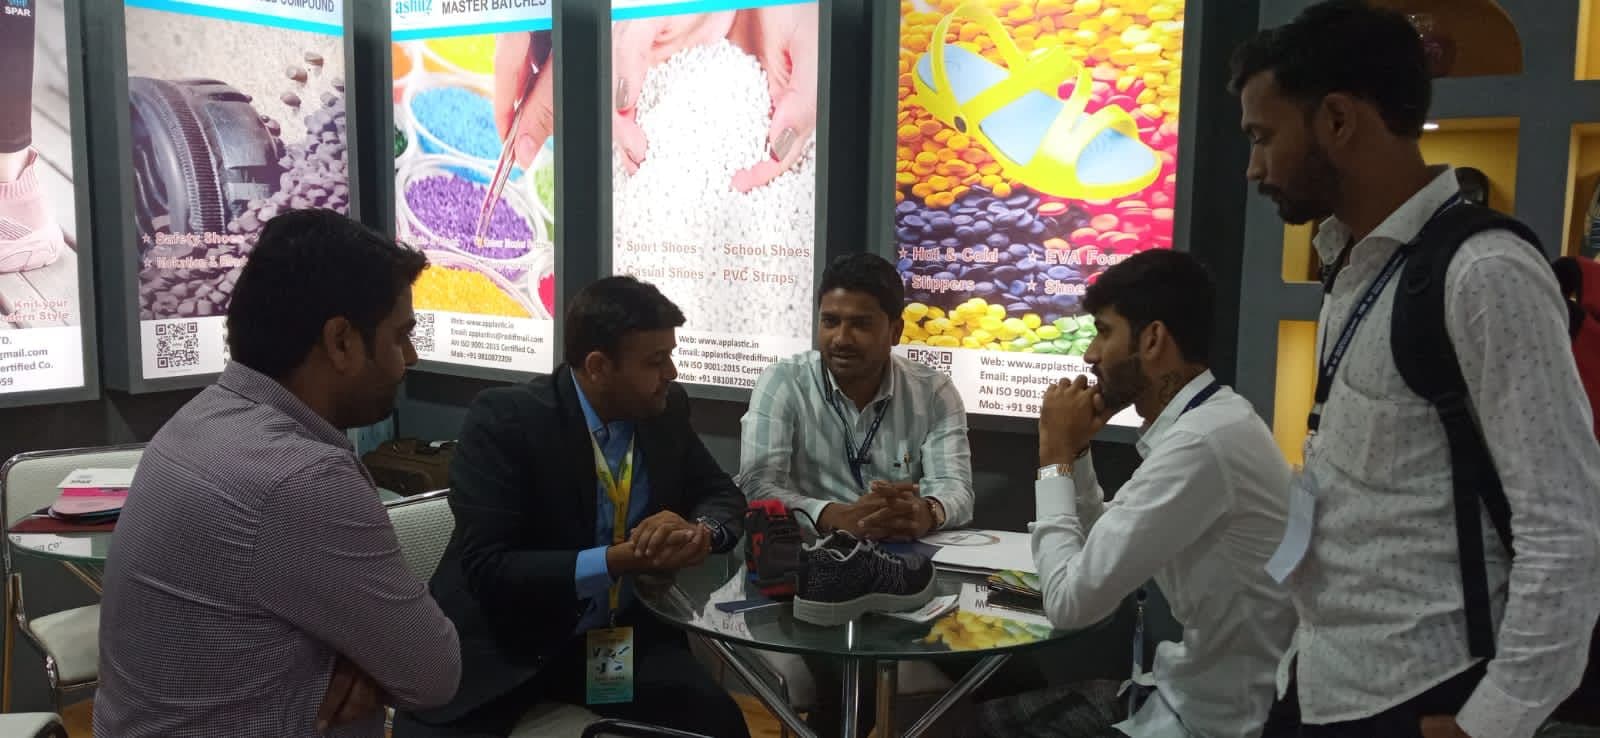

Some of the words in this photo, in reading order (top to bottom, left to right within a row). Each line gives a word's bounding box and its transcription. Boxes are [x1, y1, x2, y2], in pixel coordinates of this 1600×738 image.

[4, 6, 32, 17] SPAR
[441, 0, 489, 15] MASTER
[626, 240, 657, 254] Sport
[661, 240, 697, 254] Shoes
[723, 243, 767, 256] School
[770, 244, 810, 258] Shoes
[912, 247, 941, 262] Hot
[948, 248, 957, 262] &
[961, 247, 998, 263] Cold
[1045, 249, 1082, 264] EVA
[626, 265, 665, 278] Casual
[668, 266, 704, 280] Shoes
[723, 268, 749, 282] PVC
[752, 270, 795, 286] Straps
[911, 274, 976, 293] Slippers
[1045, 280, 1088, 296] Shoe
[39, 311, 70, 322] Style
[678, 335, 697, 344] Web:
[698, 337, 760, 349] www.applastic.in
[678, 347, 700, 357] Email:
[701, 349, 778, 364] applastics@rediffmail
[0, 361, 36, 373] ertified
[38, 361, 54, 370] Co.
[678, 360, 689, 368] AN
[690, 360, 703, 369] ISO
[704, 361, 740, 373] 9001:2015
[741, 365, 764, 375] Certif
[980, 355, 1005, 367] Web:
[1007, 359, 1092, 374] www.applastic.in
[678, 372, 697, 382] Mob:
[698, 374, 711, 383] +91
[712, 375, 756, 387] 9810872209
[979, 370, 1009, 382] Email:
[1010, 372, 1058, 386] applastics
[978, 385, 994, 395] AN
[995, 386, 1012, 397] ISO
[1013, 388, 1045, 399] 9001:2
[978, 399, 1004, 410] Mob:
[1005, 401, 1023, 413] +91
[1025, 402, 1042, 414] 981
